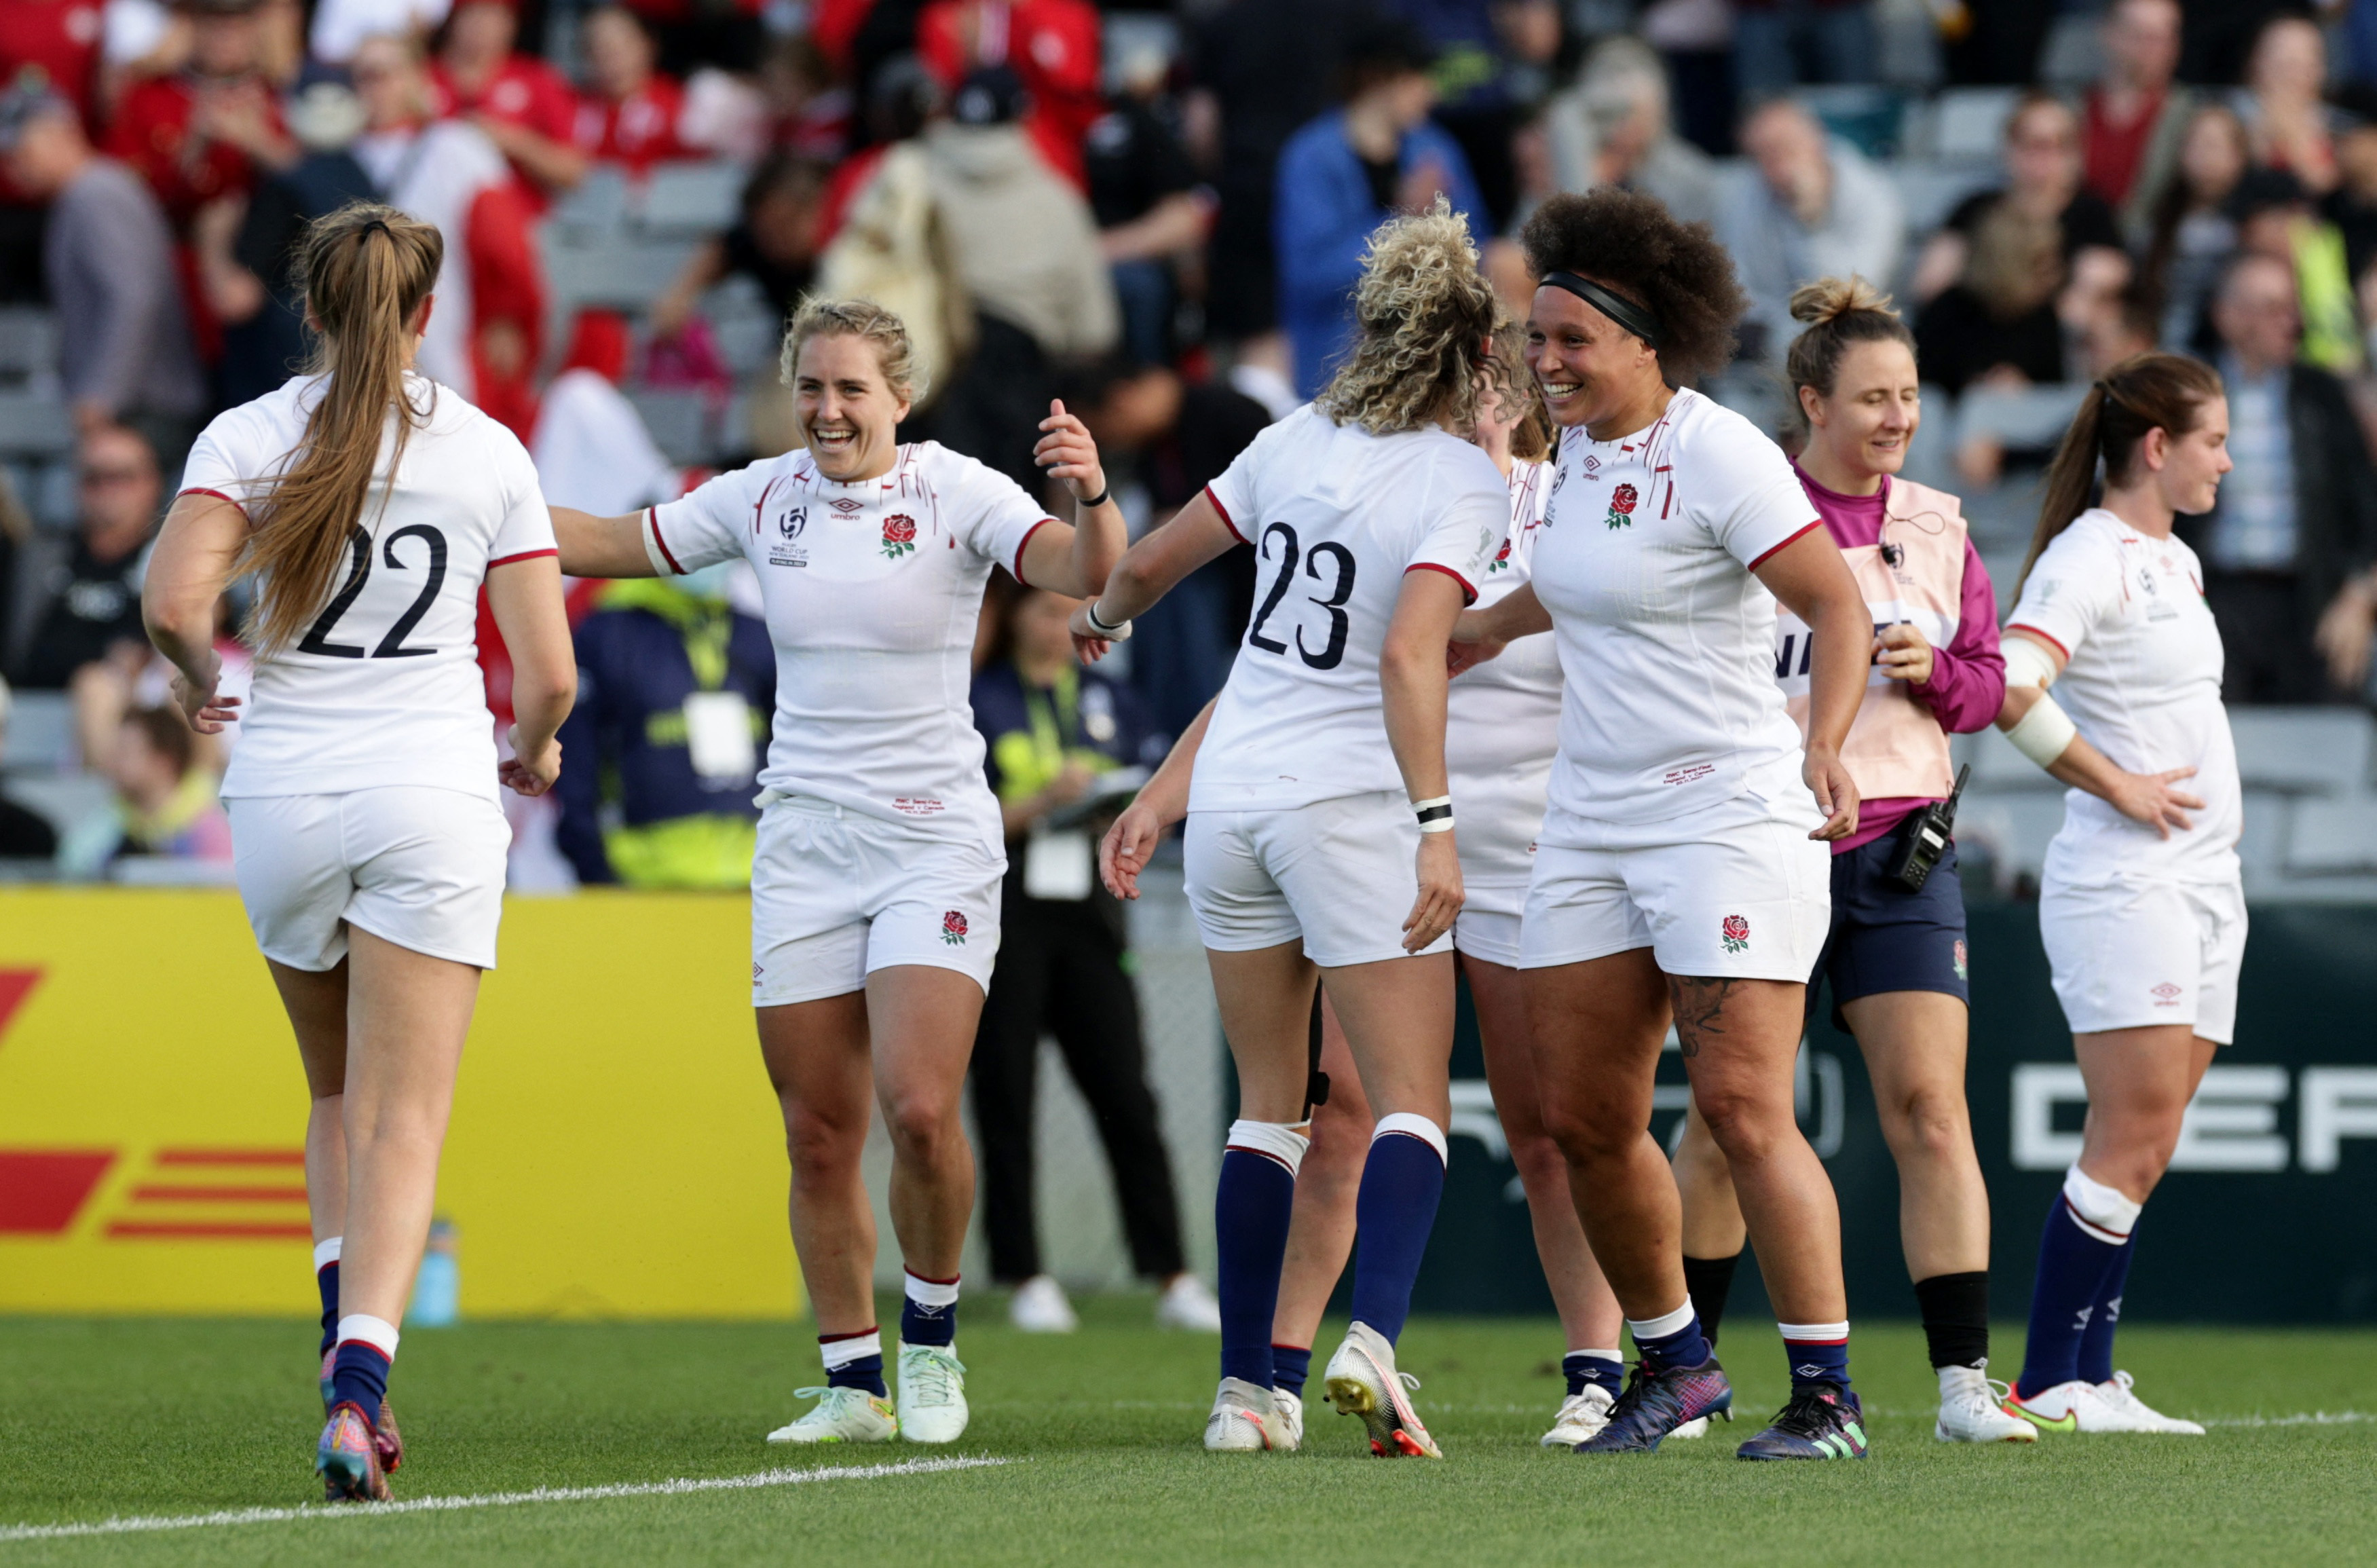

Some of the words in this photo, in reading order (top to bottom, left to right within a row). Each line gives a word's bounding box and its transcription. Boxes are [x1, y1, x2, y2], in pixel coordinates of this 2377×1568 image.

[1583, 472, 1599, 481] umbro
[830, 512, 860, 521] umbro
[297, 523, 447, 658] 22
[1249, 521, 1356, 671] 23
[1683, 764, 1712, 774] Semi-Final
[1664, 776, 1685, 784] England
